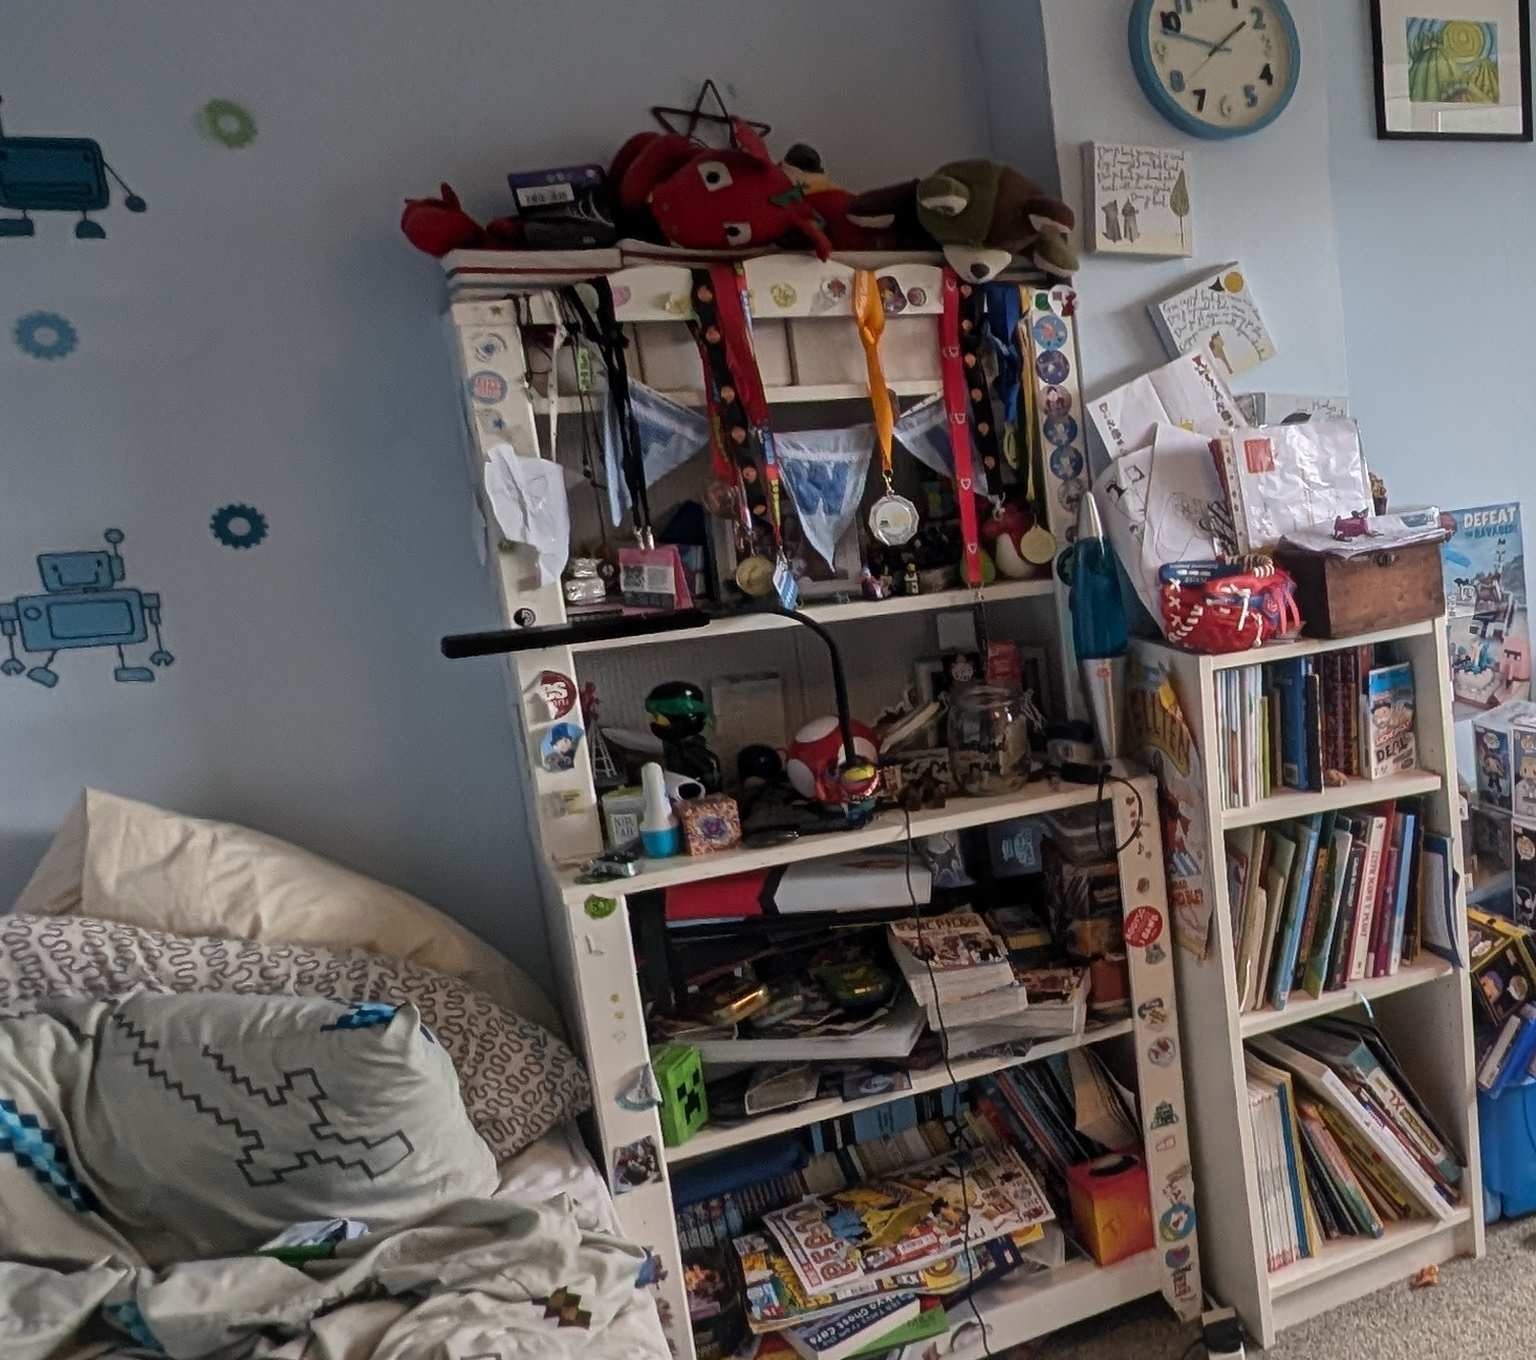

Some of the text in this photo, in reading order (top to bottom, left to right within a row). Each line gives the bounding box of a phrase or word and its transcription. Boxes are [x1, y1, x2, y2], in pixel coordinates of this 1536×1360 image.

[1250, 5, 1267, 30] 2
[1258, 63, 1274, 86] 4
[1192, 88, 1207, 113] 7
[1244, 84, 1258, 108] 5
[1463, 507, 1517, 529] DEFEAT
[1375, 737, 1409, 764] DEAL
[786, 1202, 859, 1282] BEANO
